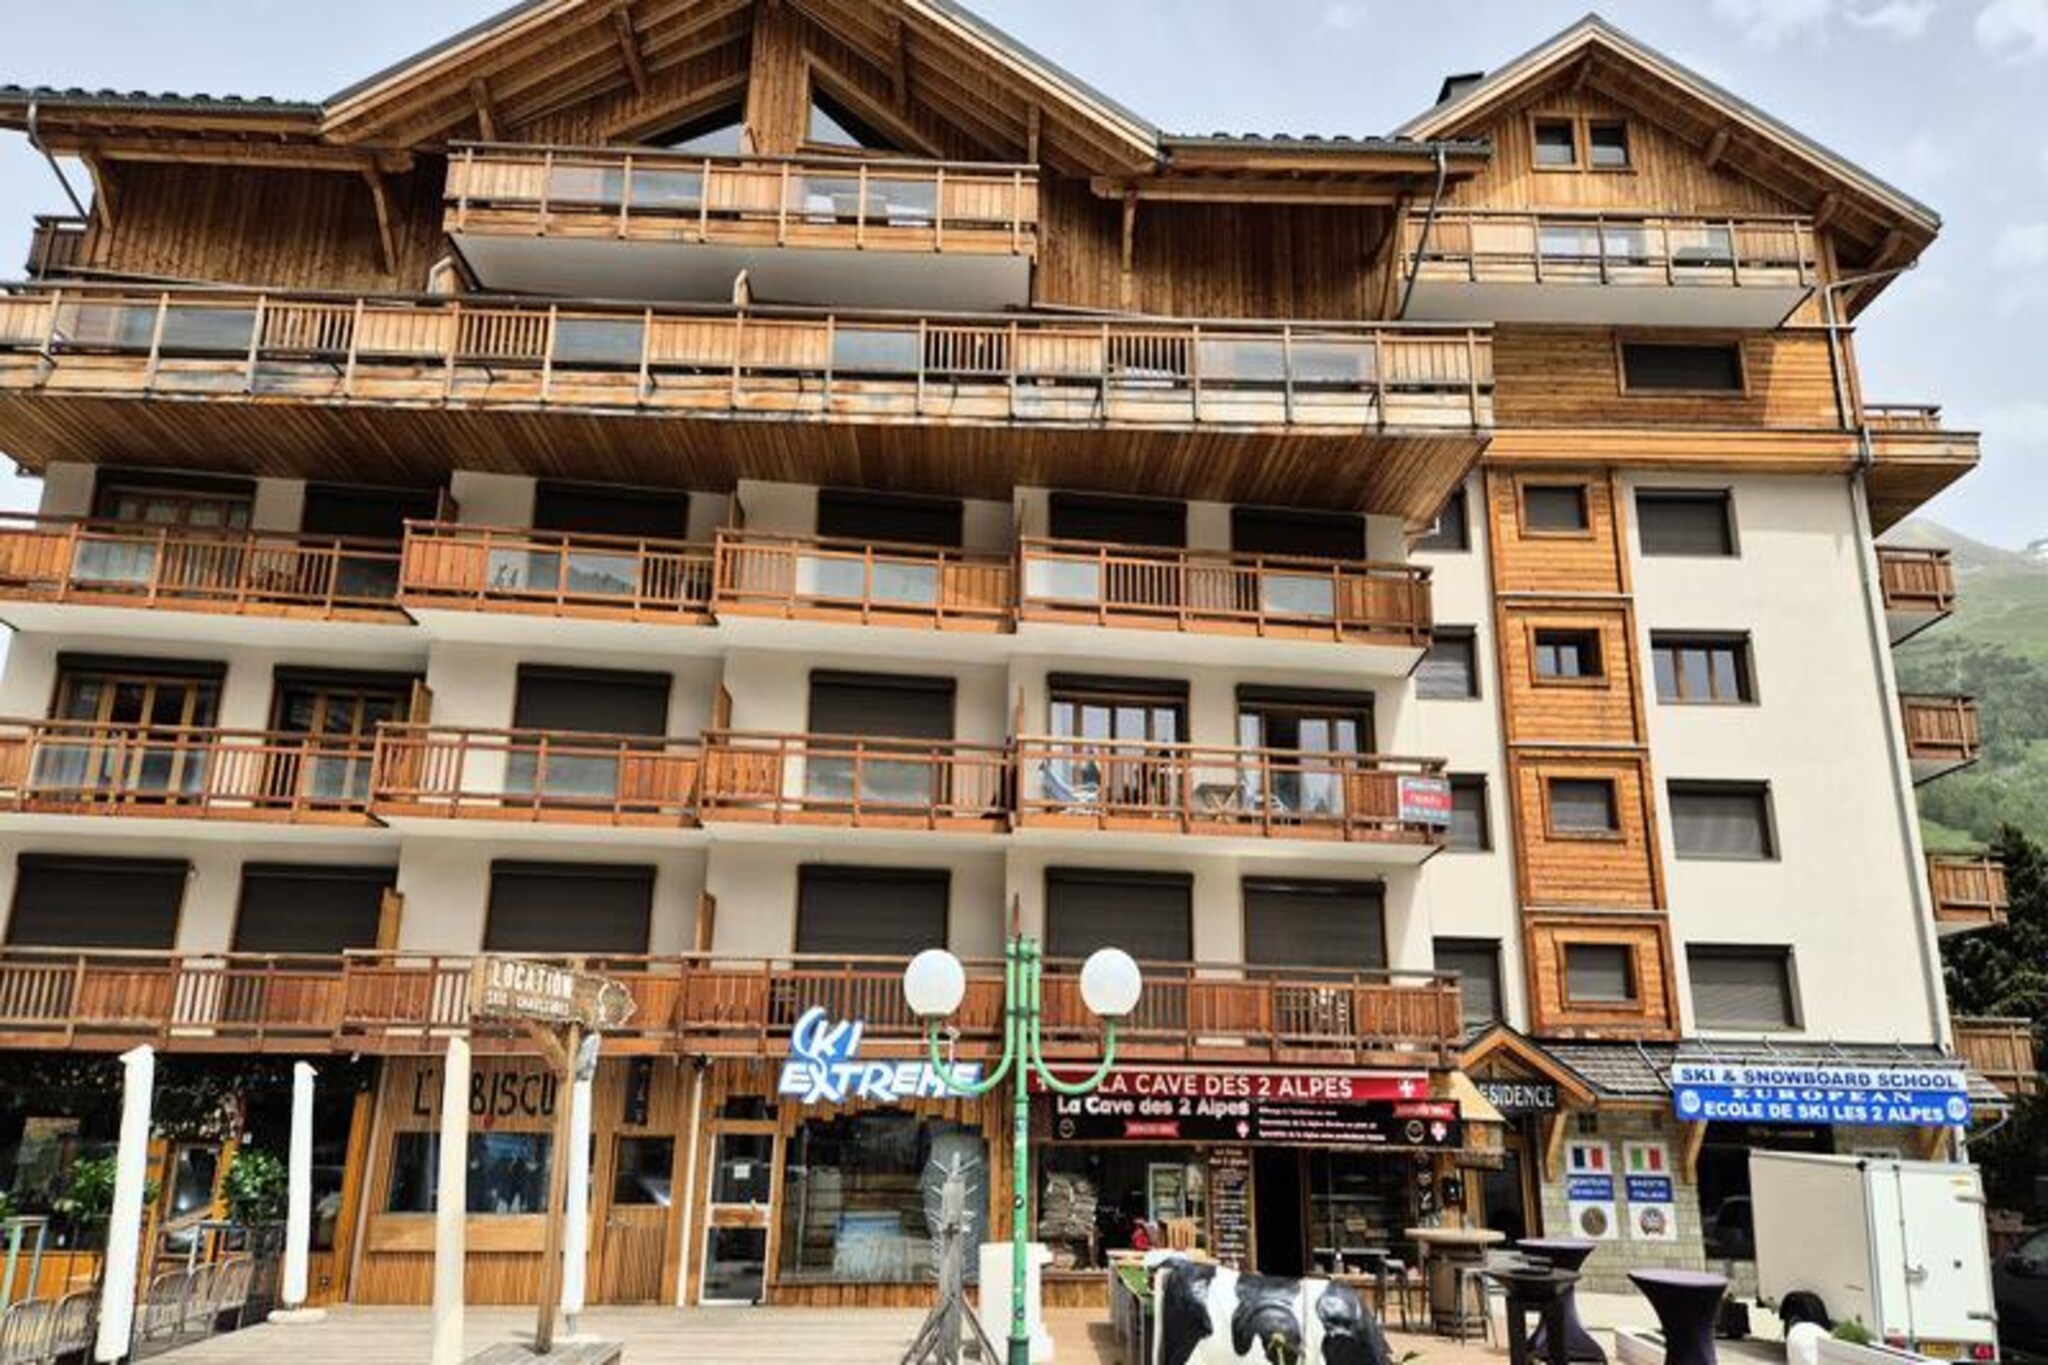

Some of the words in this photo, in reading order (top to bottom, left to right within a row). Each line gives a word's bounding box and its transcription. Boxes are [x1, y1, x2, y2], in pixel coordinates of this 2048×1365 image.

[491, 961, 574, 998] LOCATION
[779, 1061, 983, 1104] EXTREME
[1098, 1073, 1128, 1093] LA
[1136, 1074, 1198, 1095] CAVE
[1205, 1076, 1250, 1096] DES
[1258, 1077, 1271, 1096] 2
[1278, 1077, 1353, 1098] ALPES
[1681, 1068, 1716, 1082] SKI
[1722, 1069, 1737, 1083] &
[1743, 1069, 1871, 1087] SNOWBOARD
[1878, 1073, 1959, 1089] SCHOOL
[1057, 1095, 1082, 1115] La
[1085, 1096, 1134, 1115] Cave
[1139, 1097, 1174, 1115] des
[1179, 1098, 1193, 1115] 2
[1197, 1099, 1250, 1120] Alpes
[1478, 1083, 1555, 1108] ESIDENCE
[1732, 1088, 1913, 1103] EUROPEAN
[1704, 1101, 1764, 1118] ECOLE
[1768, 1103, 1793, 1119] DE
[1798, 1104, 1828, 1120] SKI
[1833, 1105, 1867, 1120] LES
[1872, 1106, 1884, 1121] 2
[1888, 1107, 1944, 1122] ALPES
